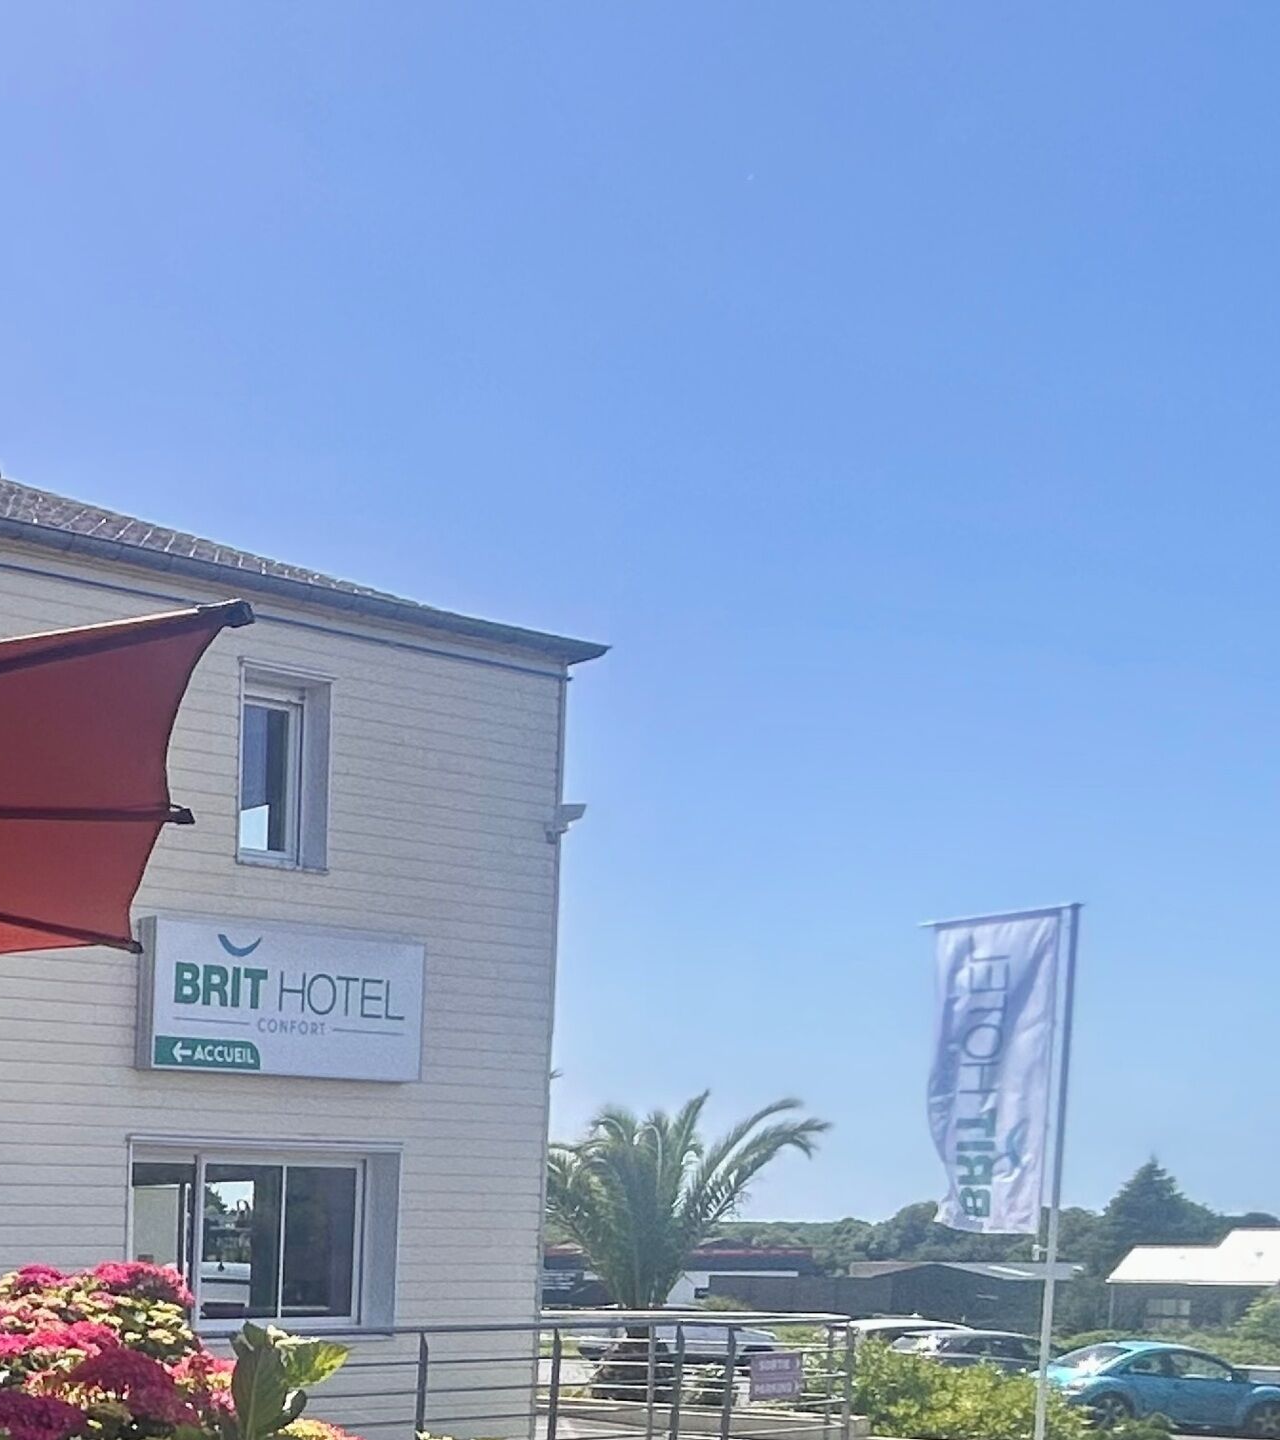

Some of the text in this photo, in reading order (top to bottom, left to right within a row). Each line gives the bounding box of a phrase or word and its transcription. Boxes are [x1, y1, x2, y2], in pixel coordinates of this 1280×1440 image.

[174, 961, 405, 1021] BRIT HOTEL
[257, 1018, 326, 1036] CONFORT
[193, 1046, 255, 1064] ACCUEIL
